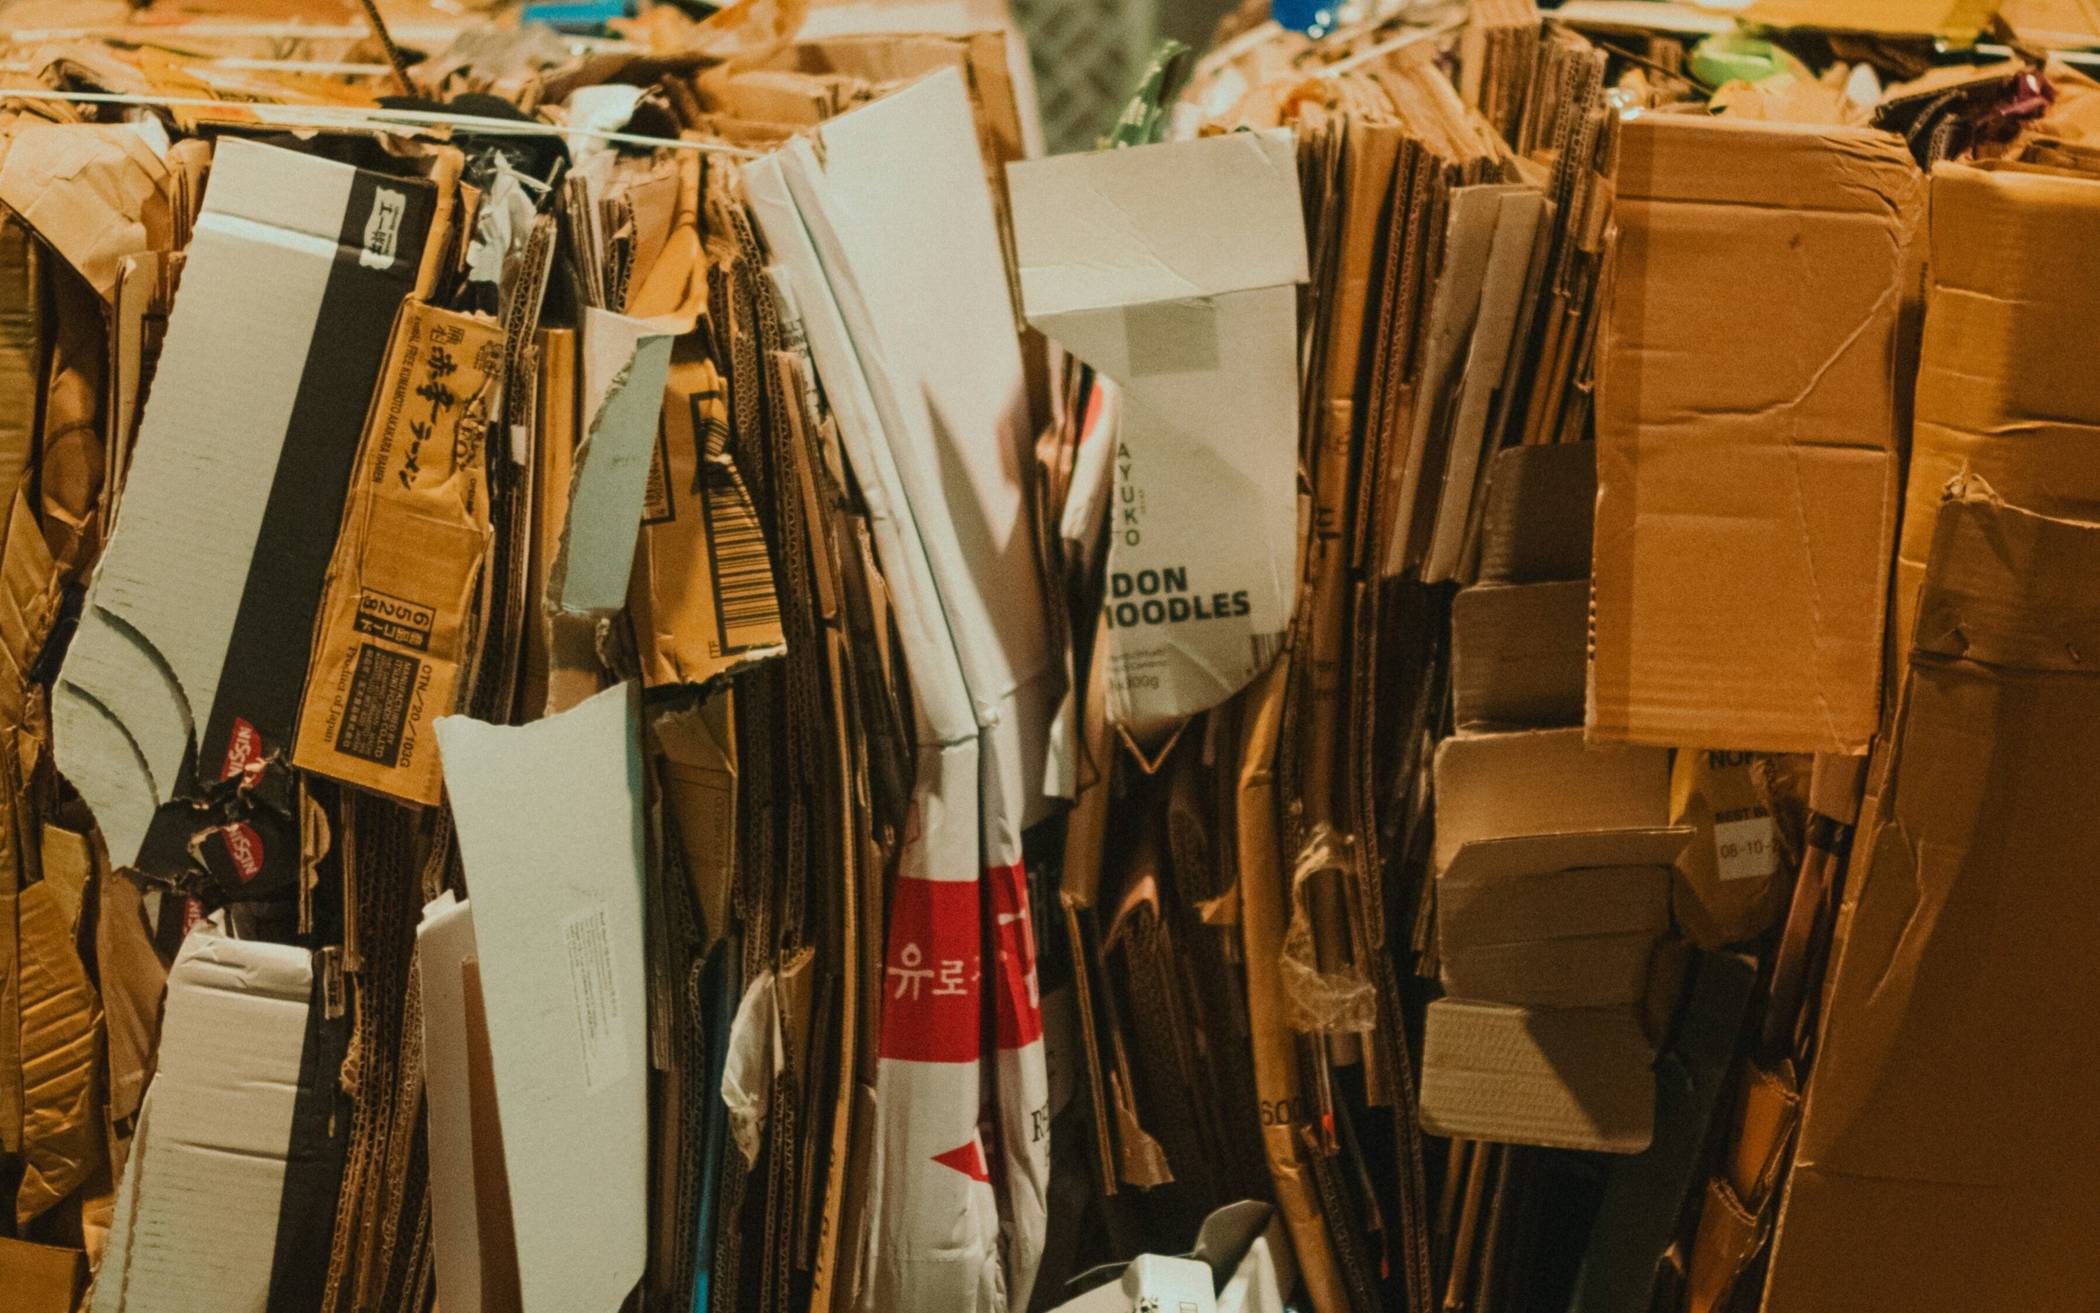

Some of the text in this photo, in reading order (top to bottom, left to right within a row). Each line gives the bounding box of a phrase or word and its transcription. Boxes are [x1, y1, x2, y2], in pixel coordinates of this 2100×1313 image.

[404, 345, 418, 367] FREE
[390, 367, 411, 414] KUMAMOTO
[381, 414, 399, 452] AKAKARA
[1111, 566, 1188, 599] DON
[362, 595, 430, 627] 6528
[324, 646, 357, 743] Product of Japan
[229, 829, 258, 874] NISSIN
[1720, 839, 1771, 859] 08-10-
[887, 942, 981, 1001] 유로
